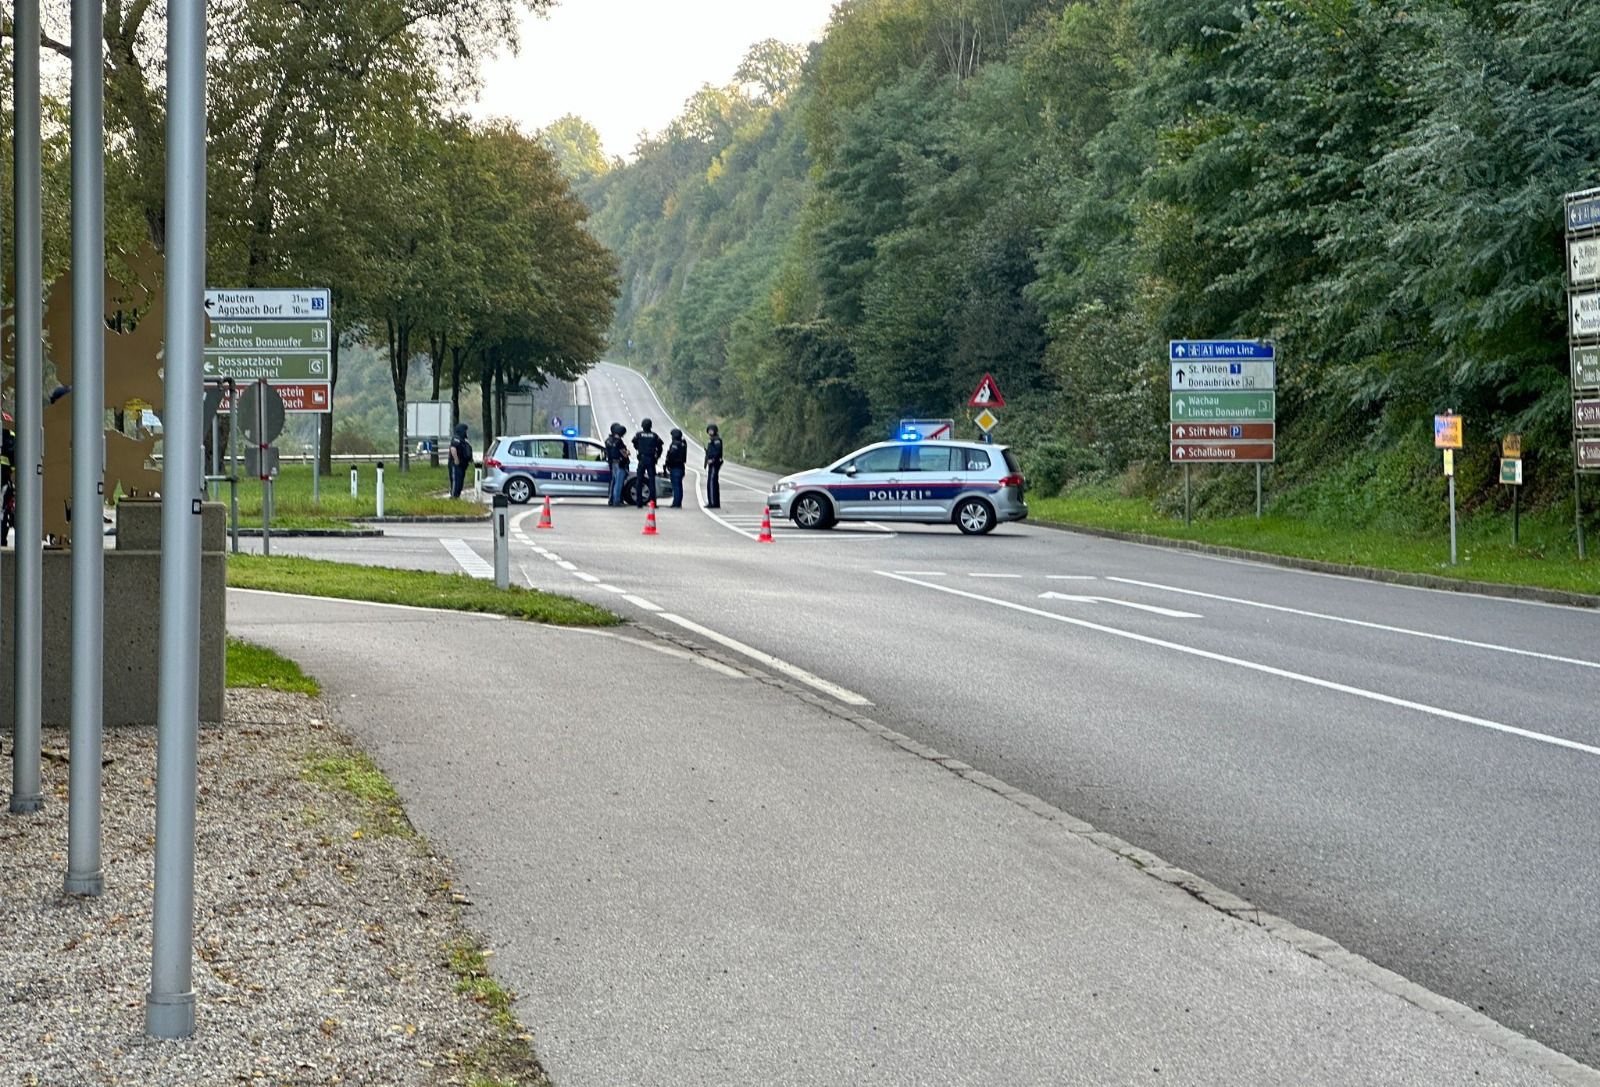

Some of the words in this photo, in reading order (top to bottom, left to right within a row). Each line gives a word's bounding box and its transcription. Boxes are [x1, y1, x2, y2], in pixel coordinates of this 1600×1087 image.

[217, 294, 255, 303] Mautern
[218, 304, 260, 316] Aggsbach
[263, 305, 282, 314] Dorf
[218, 324, 252, 334] Wachau
[313, 330, 324, 340] 33
[218, 337, 253, 347] Rechtes
[256, 337, 302, 347] Donauufer
[1203, 345, 1212, 355] A1
[1215, 345, 1235, 355] Wien
[1237, 345, 1254, 355] Linz
[217, 356, 282, 366] Rossatzbach
[217, 367, 279, 378] Schönbühel
[1188, 365, 1199, 373] St.
[1202, 364, 1228, 373] Pölten
[1188, 379, 1240, 387] Donaubrücke
[1188, 396, 1219, 405] Wachau
[1188, 407, 1213, 417] Linkes
[1216, 407, 1256, 417] Donauufer
[1188, 427, 1206, 437] Stift
[1209, 427, 1228, 437] Melk
[1188, 448, 1236, 458] Schallaburg
[551, 472, 592, 482] POLIZEI
[868, 490, 923, 500] POLIZEI
